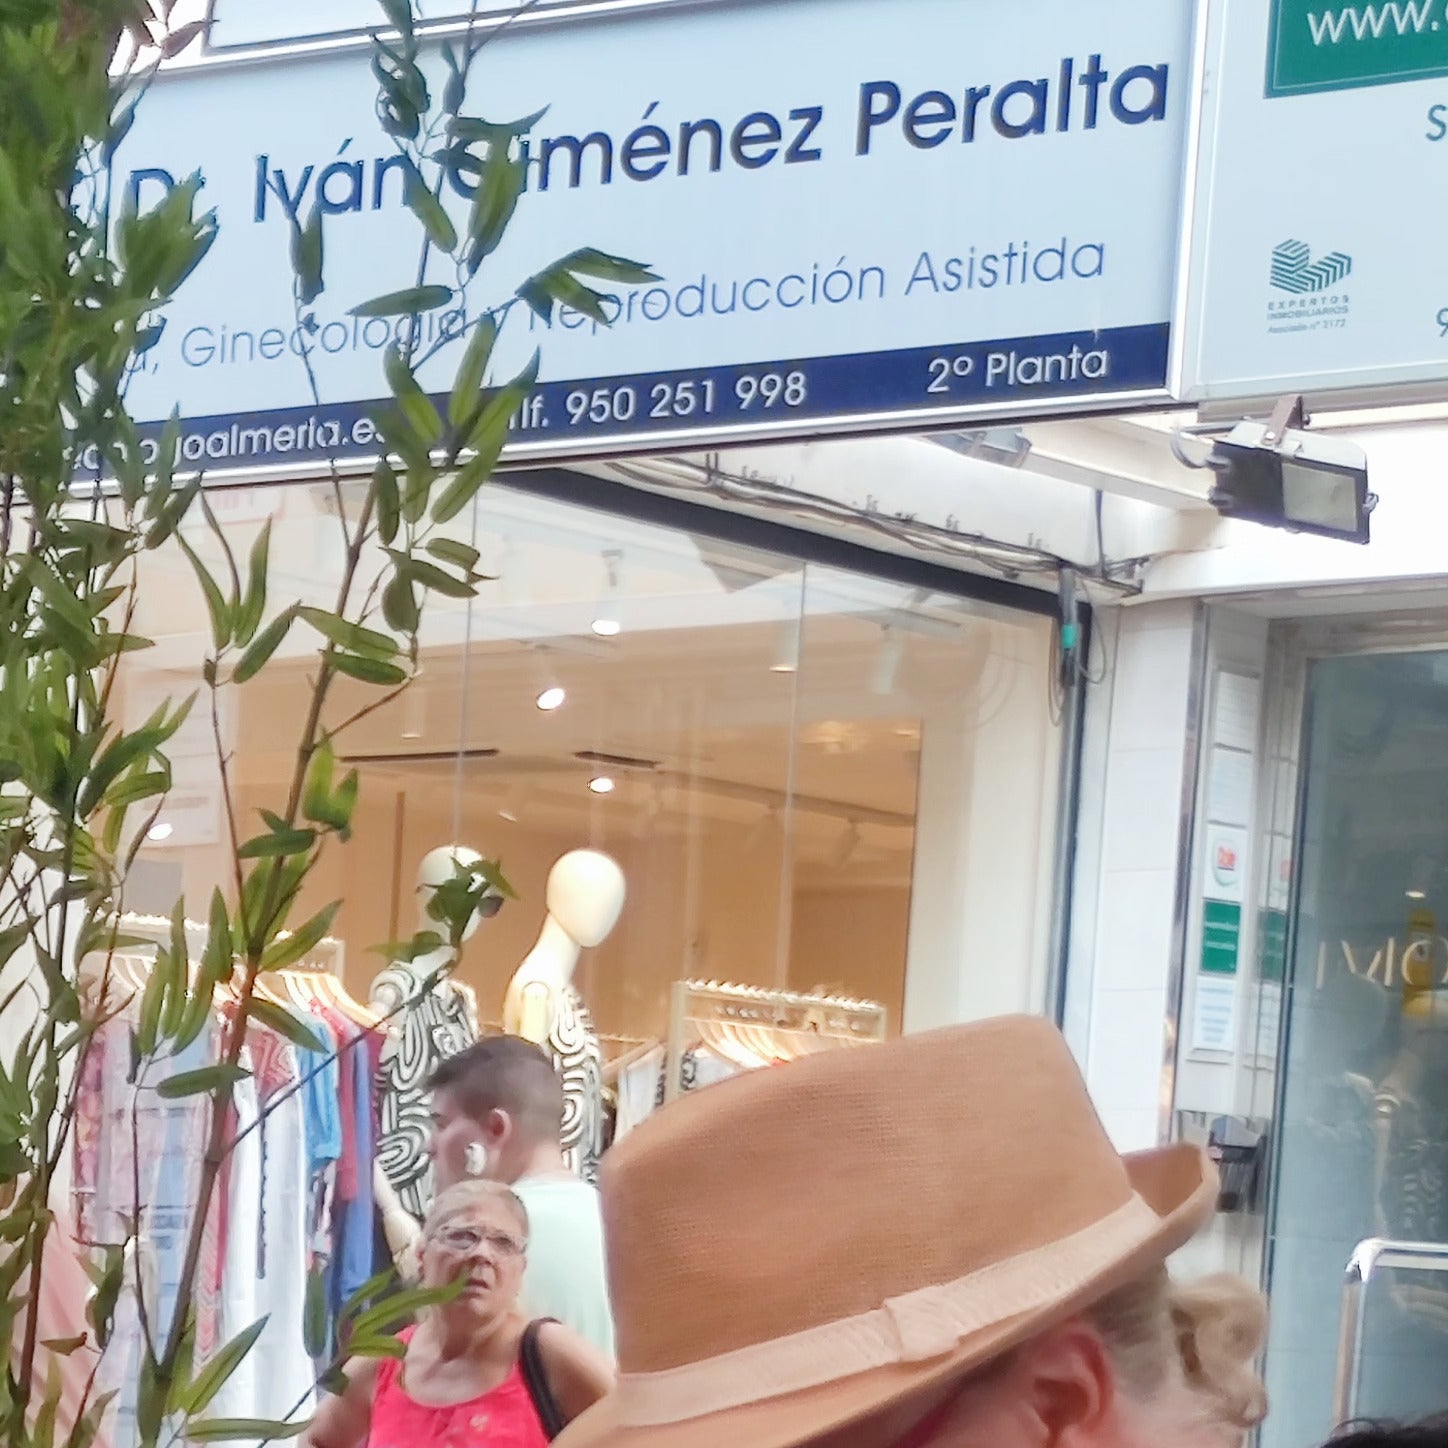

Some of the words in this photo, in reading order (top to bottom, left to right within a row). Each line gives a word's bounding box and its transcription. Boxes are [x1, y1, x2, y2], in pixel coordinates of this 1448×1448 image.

[856, 54, 1170, 156] Peralta
[904, 236, 1106, 297] Asistida
[566, 390, 637, 425] 950
[651, 379, 714, 417] 251
[734, 371, 807, 410] 998
[927, 355, 974, 395] 2º
[986, 342, 1110, 389] Planta
